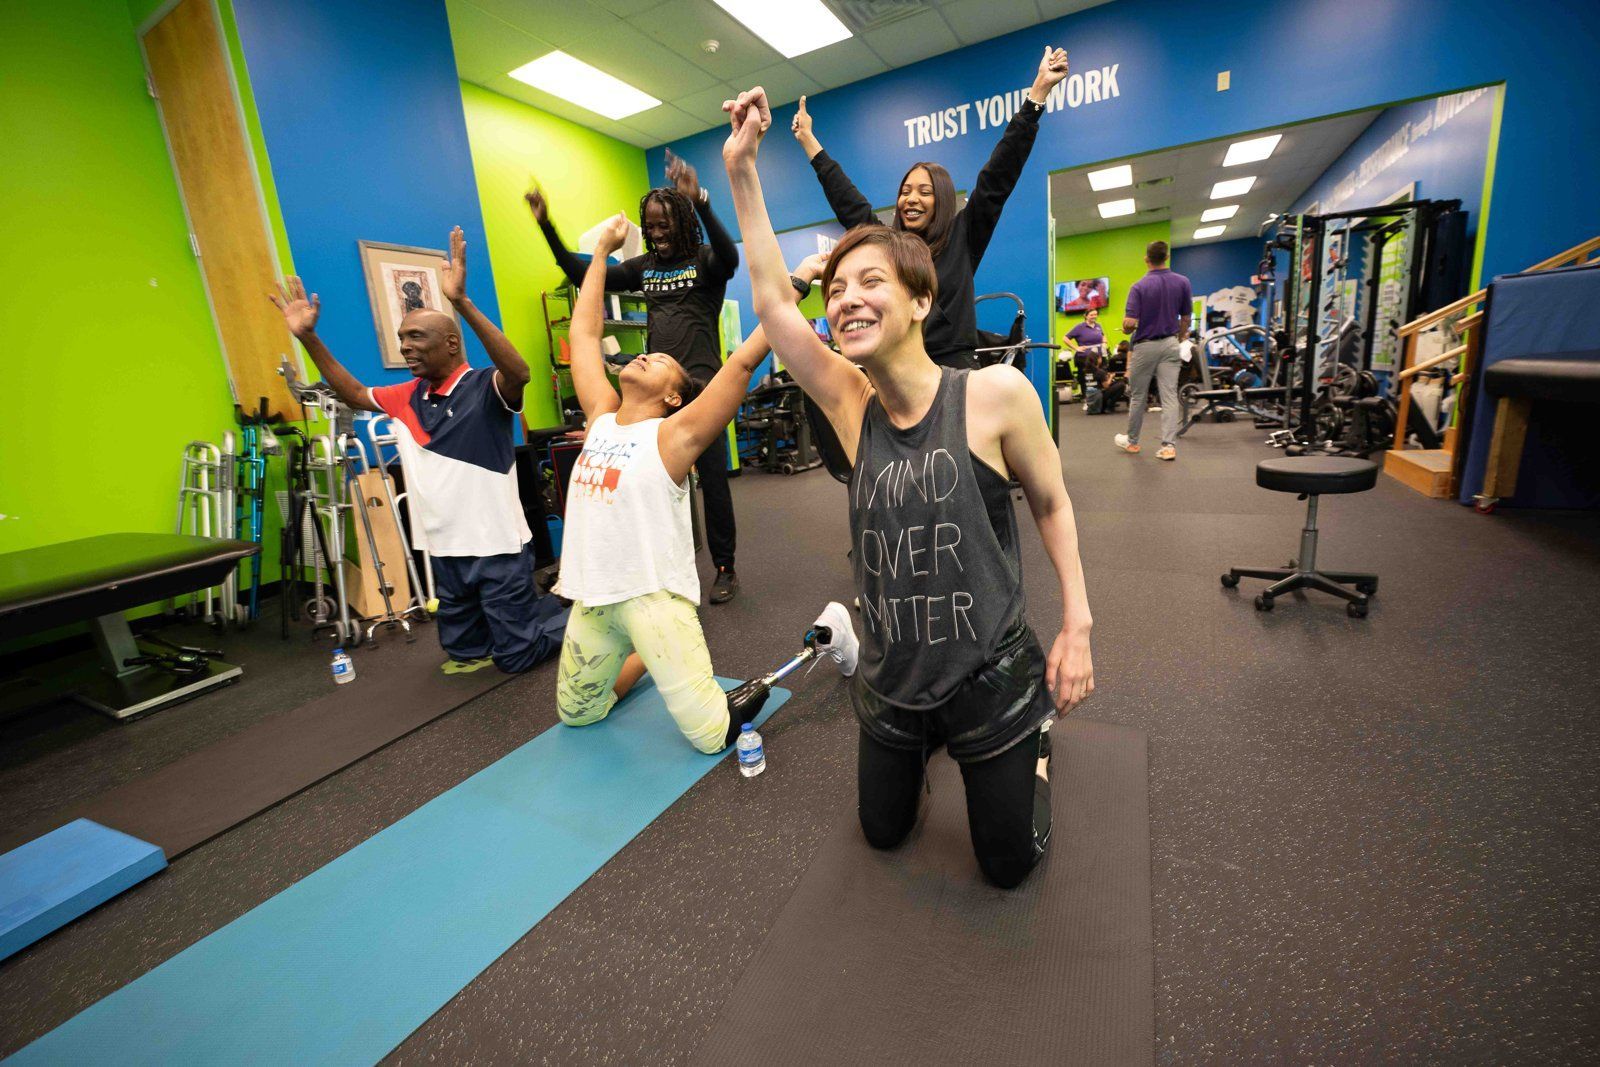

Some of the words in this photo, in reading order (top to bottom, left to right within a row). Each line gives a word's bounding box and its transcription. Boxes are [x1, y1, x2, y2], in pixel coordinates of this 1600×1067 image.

[904, 103, 970, 148] TRUST
[1045, 63, 1121, 114] WORK
[643, 279, 694, 292] FITNESS
[856, 448, 959, 509] MIND
[862, 522, 964, 580] OVER
